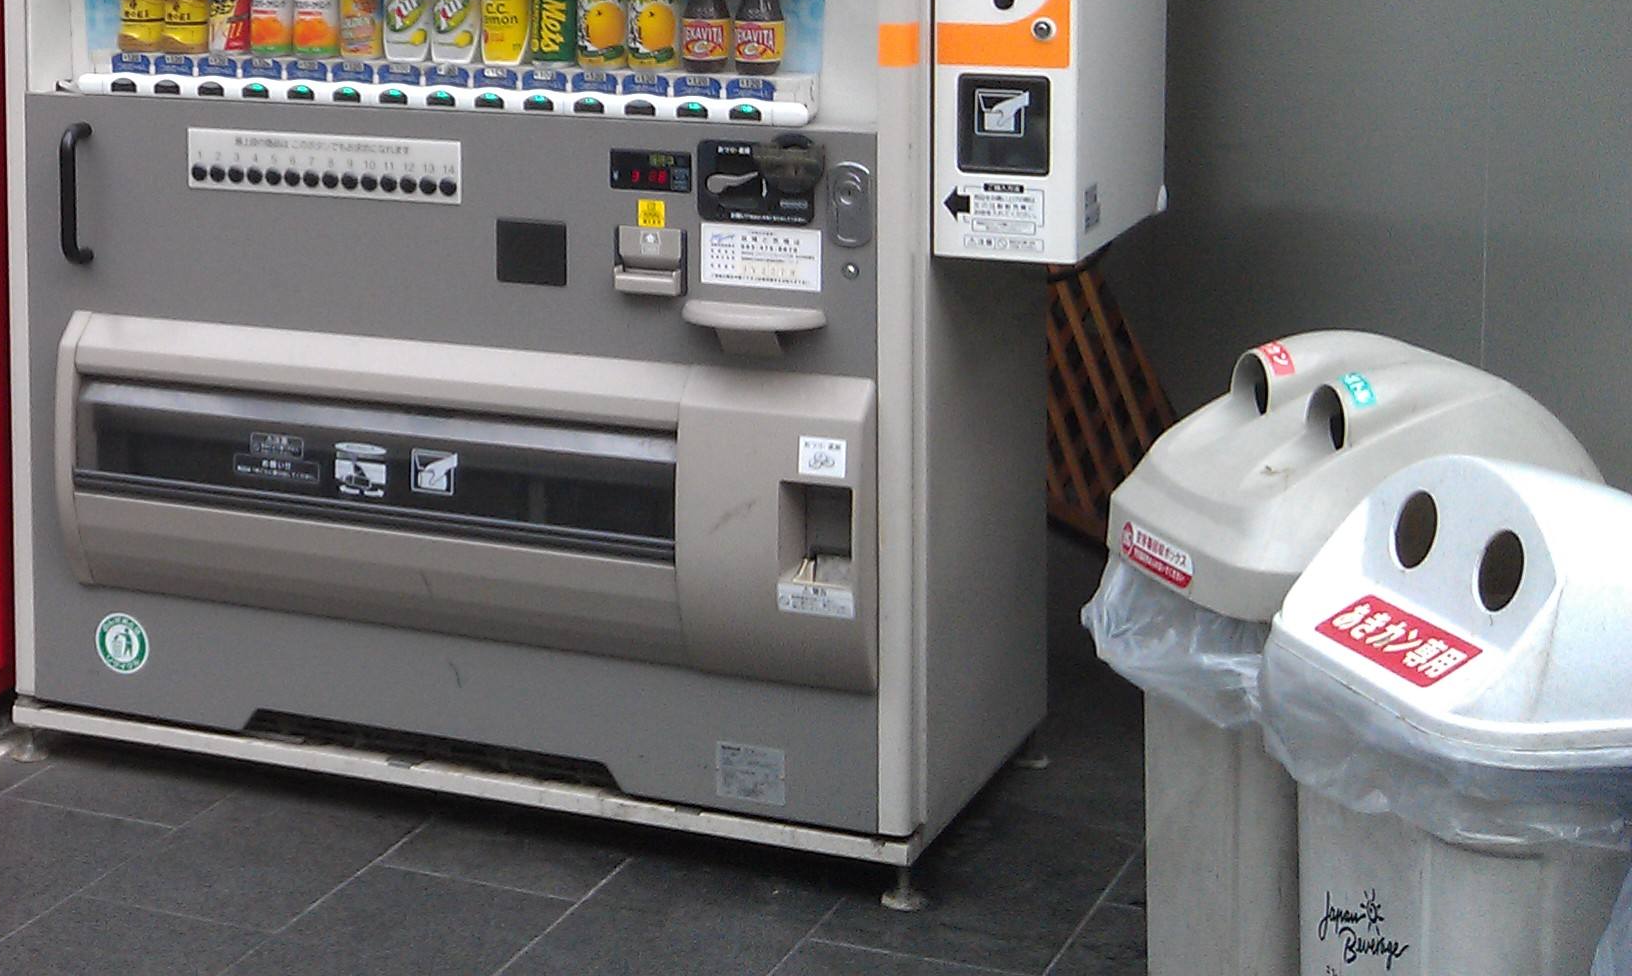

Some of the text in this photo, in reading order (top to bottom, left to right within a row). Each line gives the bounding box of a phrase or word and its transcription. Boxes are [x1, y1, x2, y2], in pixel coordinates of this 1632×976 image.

[215, 151, 221, 161] 2
[234, 152, 240, 162] 3
[252, 153, 258, 163] 4
[270, 154, 277, 164] 5
[289, 155, 296, 165] 6
[308, 156, 315, 166] 7
[328, 157, 334, 167] 8
[347, 158, 354, 168] 9
[363, 159, 376, 170] 10
[383, 160, 395, 171] 11
[402, 162, 415, 173] 12
[422, 163, 435, 174] 13
[442, 164, 455, 175] 14
[1331, 601, 1470, 680] あきカン専用
[1319, 890, 1366, 942] Japan
[1338, 926, 1409, 972] Beverage
